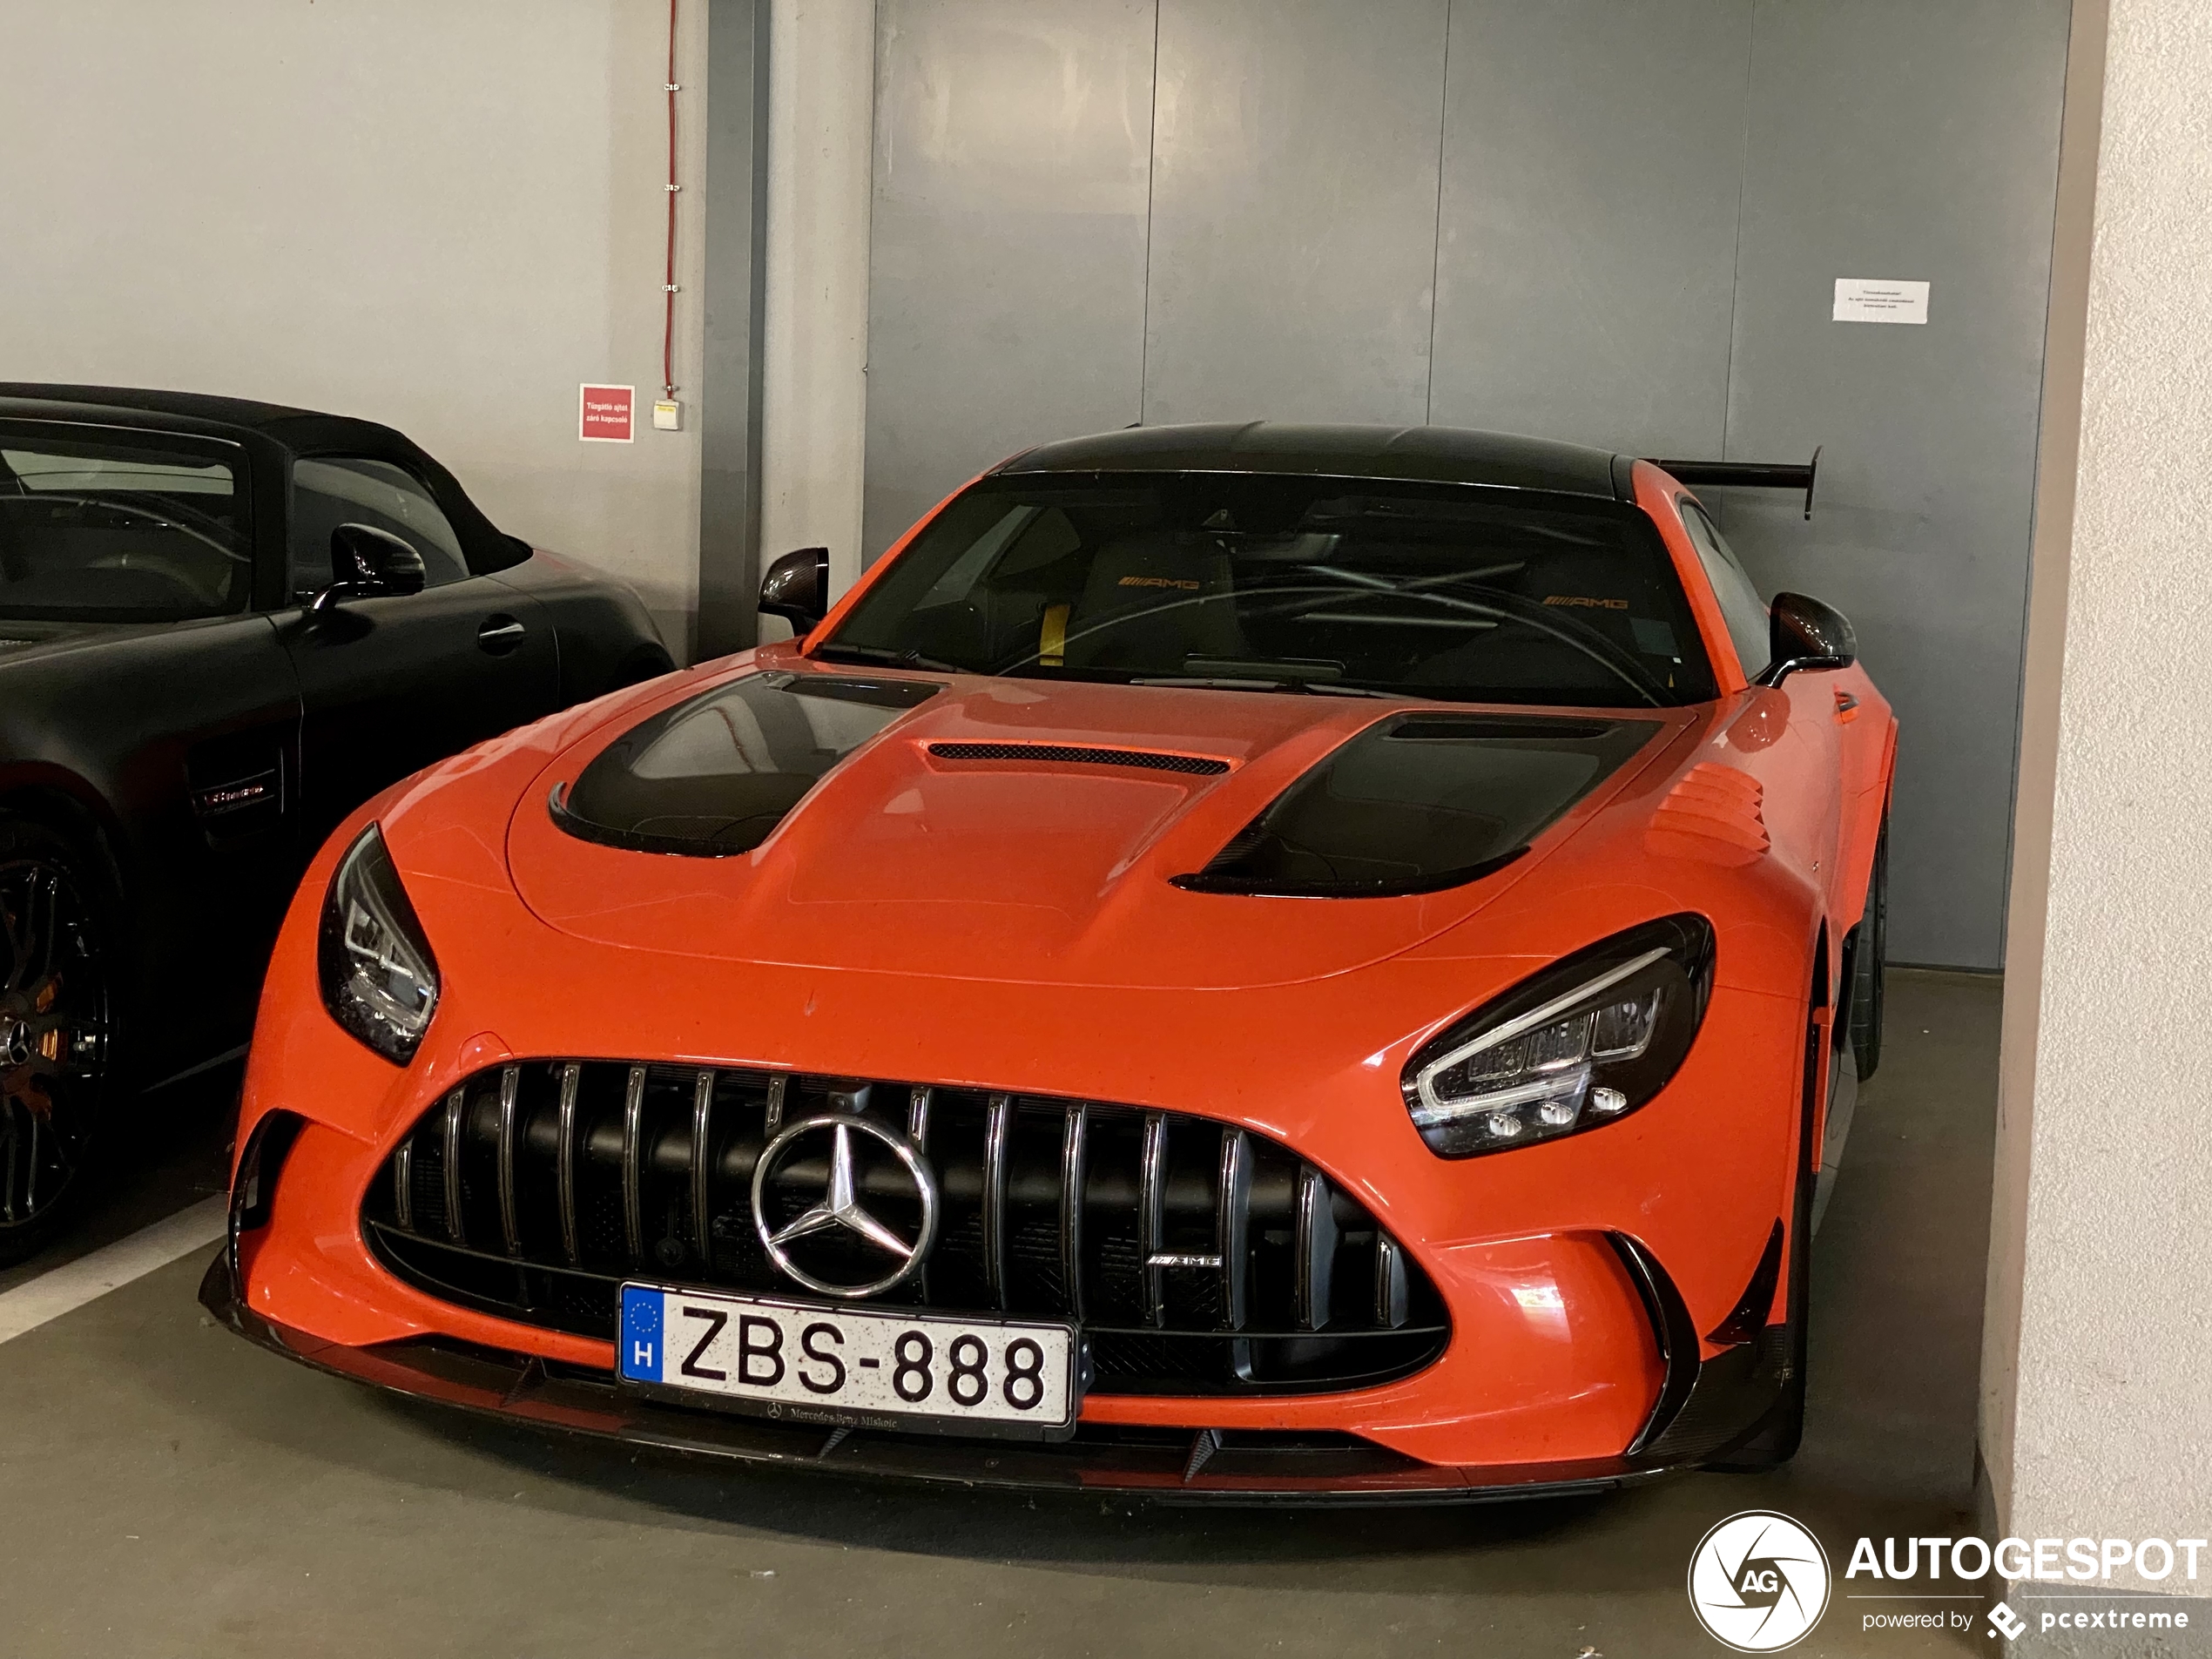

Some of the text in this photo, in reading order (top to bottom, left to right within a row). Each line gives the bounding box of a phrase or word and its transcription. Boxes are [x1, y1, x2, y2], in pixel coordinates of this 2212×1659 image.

[600, 415, 628, 424] kapcsoló
[1143, 577, 1199, 590] AMG
[1569, 597, 1629, 610] AMG
[634, 1340, 652, 1368] H
[680, 1305, 1044, 1410] ZBS-888
